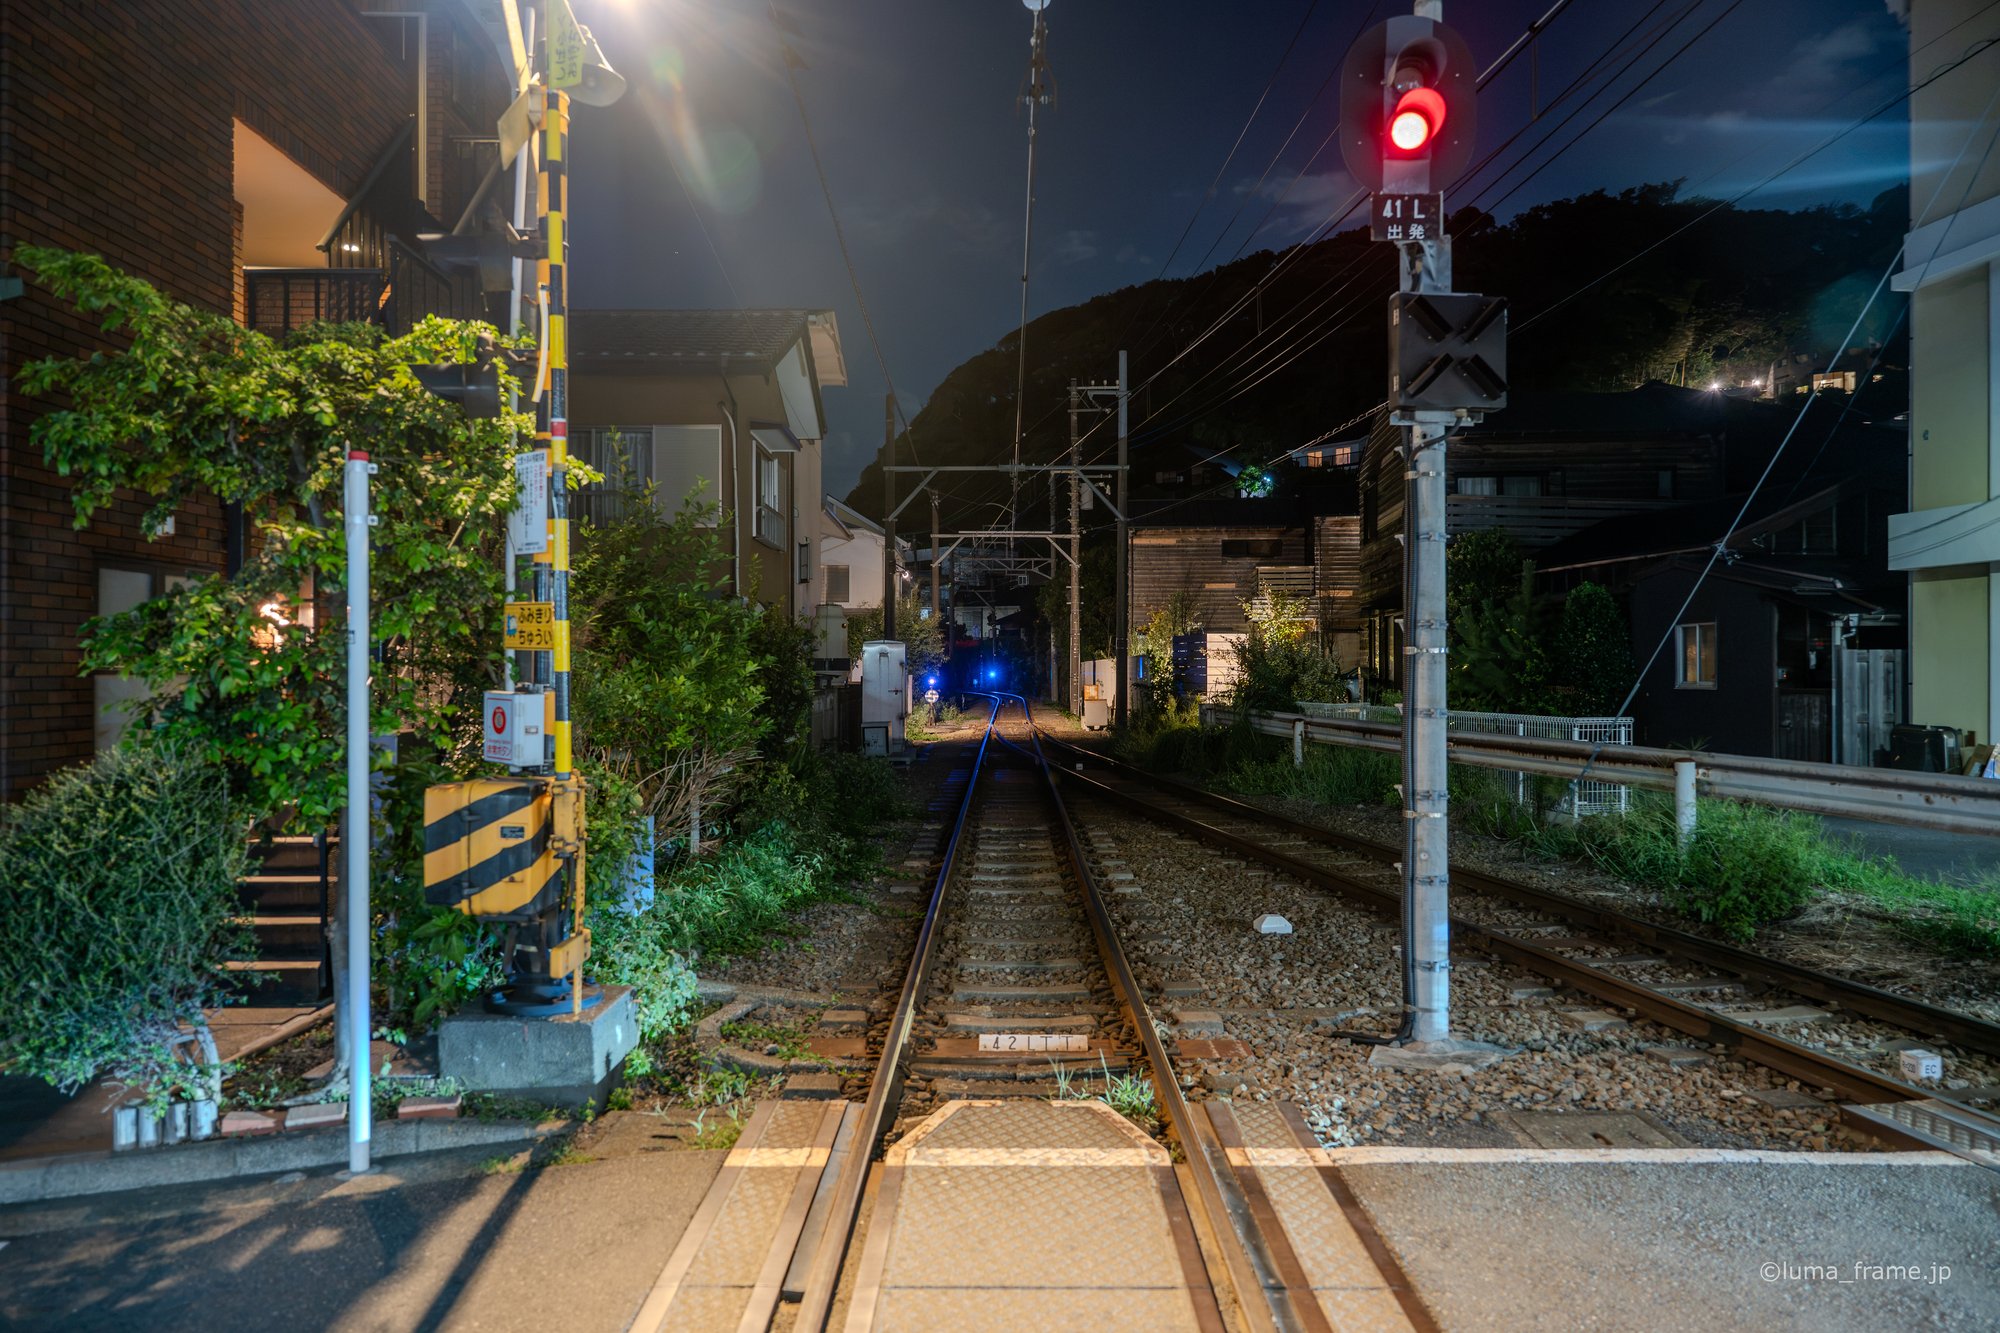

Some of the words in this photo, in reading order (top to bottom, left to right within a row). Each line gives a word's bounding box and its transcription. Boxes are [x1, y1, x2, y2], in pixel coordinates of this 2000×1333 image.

[1383, 199, 1402, 218] 41
[1413, 199, 1426, 219] L
[1387, 223, 1425, 240] 出発
[519, 607, 552, 624] ふみきり
[518, 628, 553, 646] ちゅうい
[1925, 1064, 1936, 1074] EC
